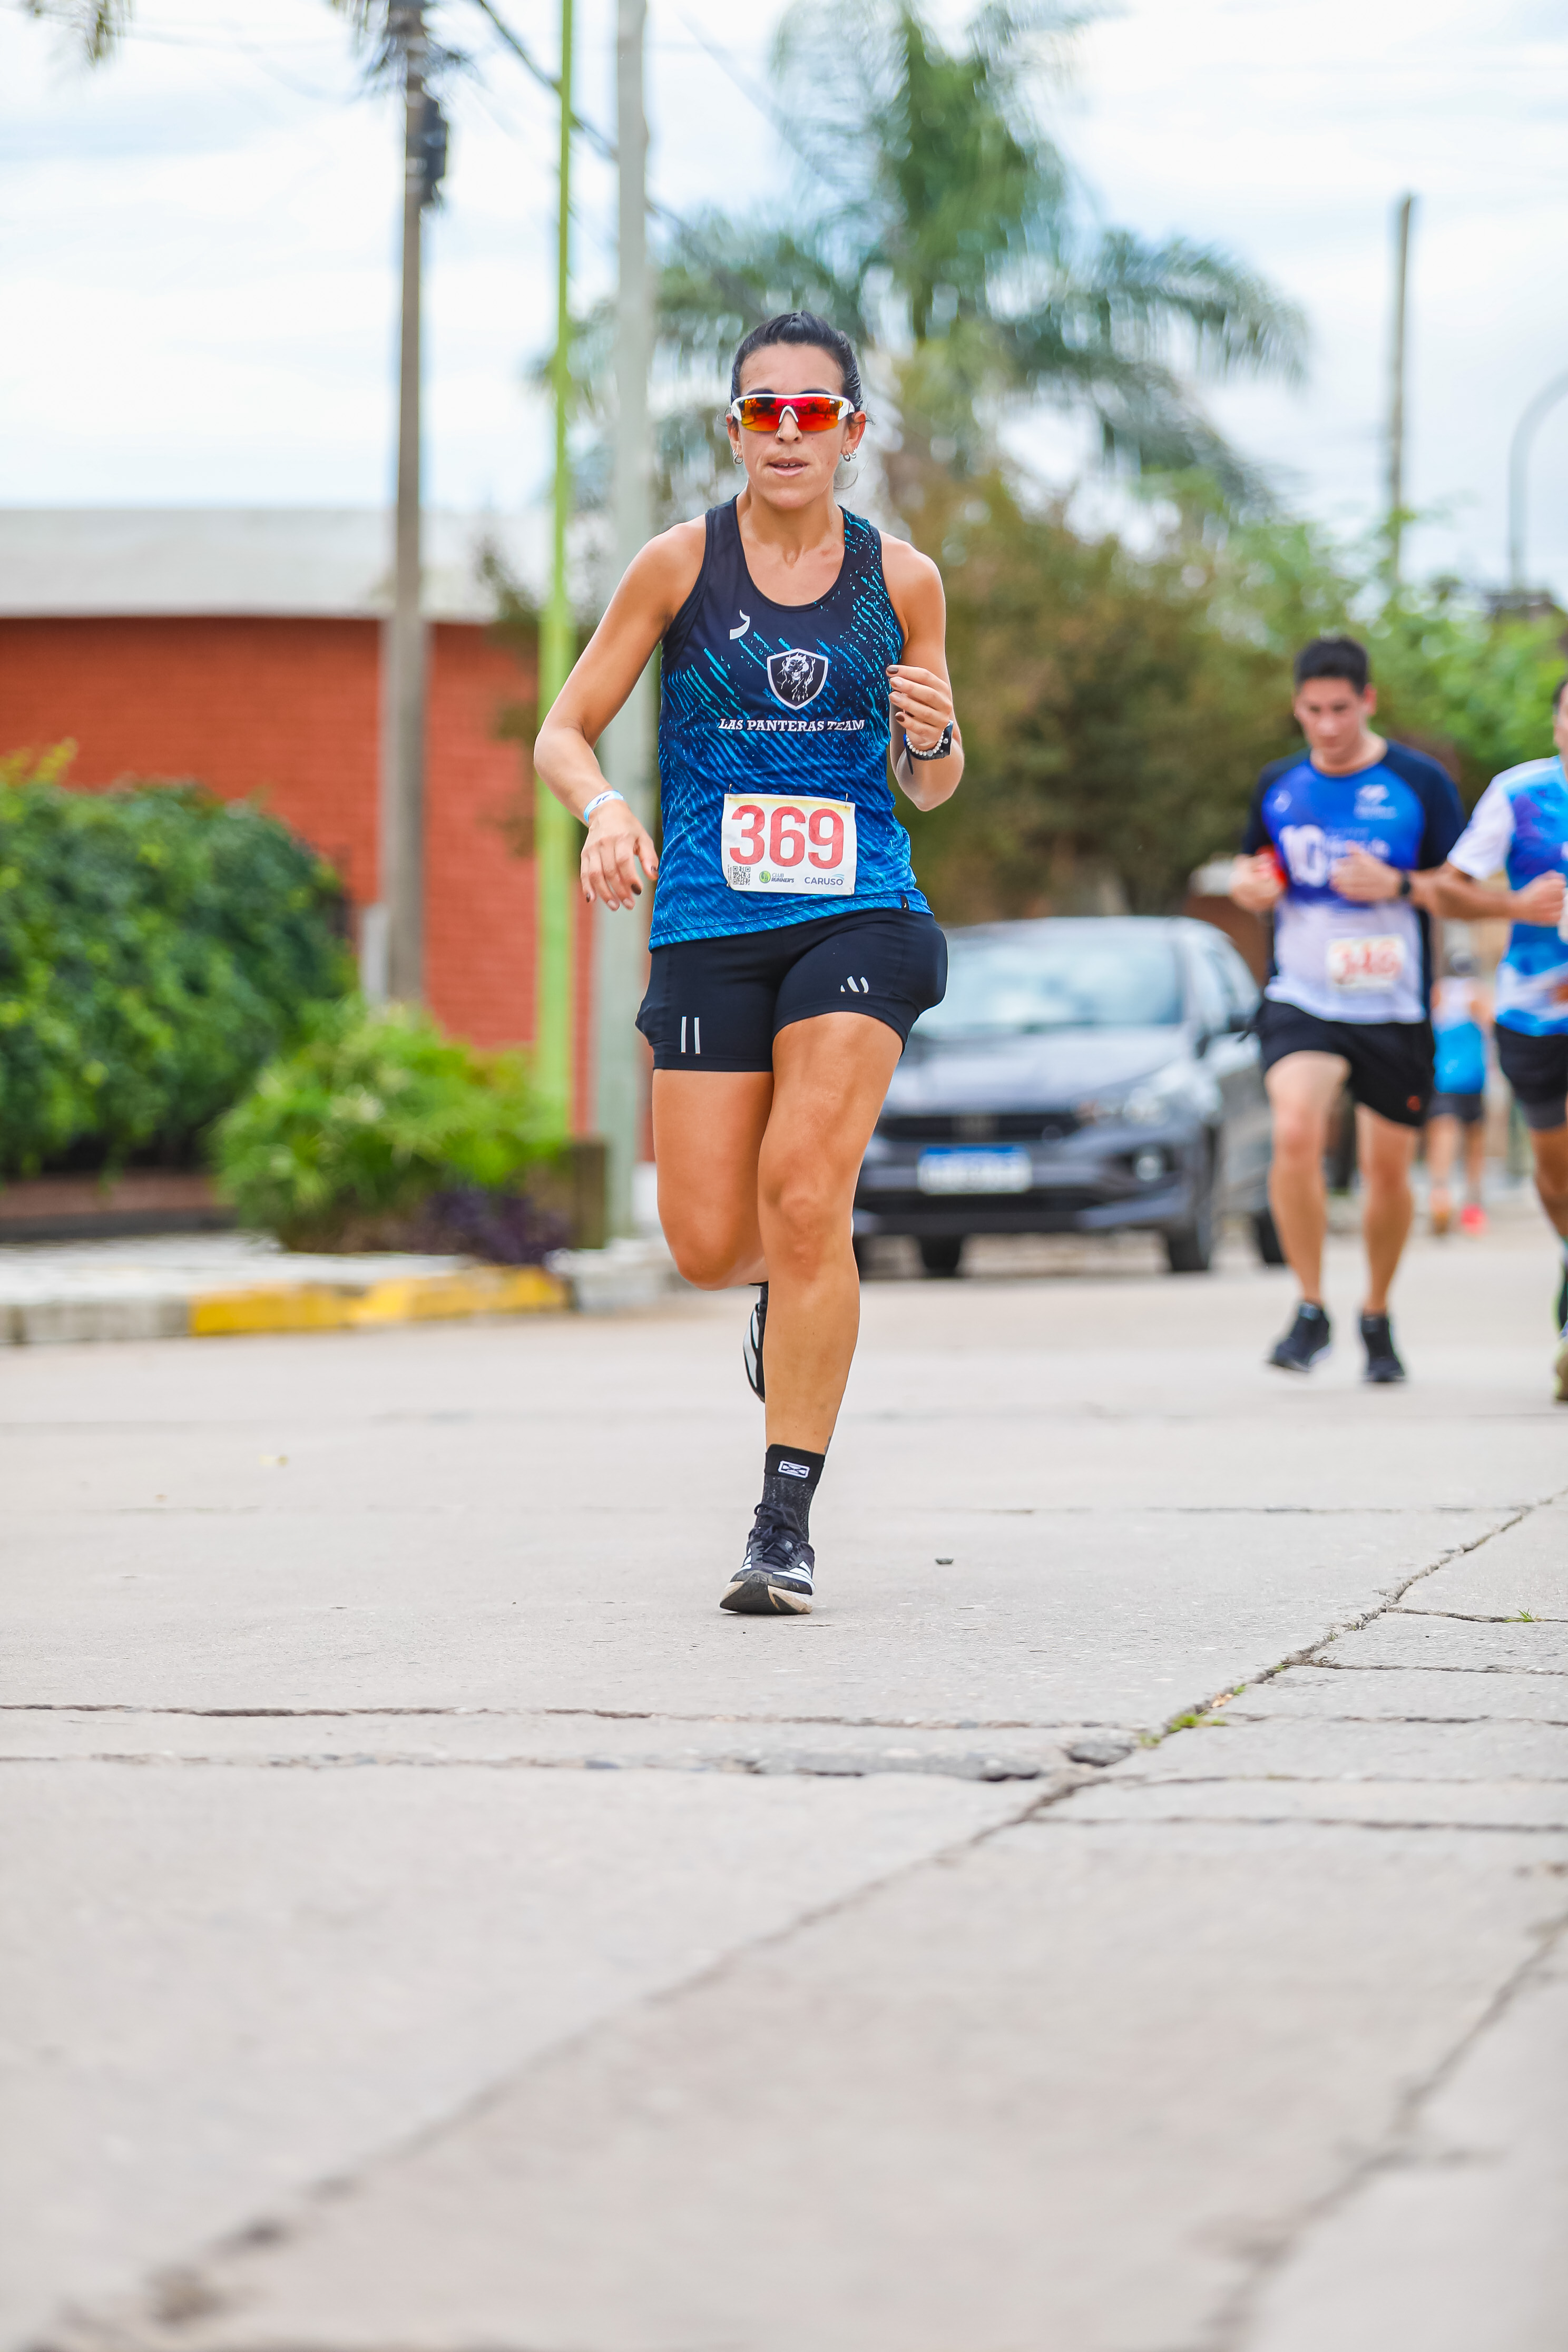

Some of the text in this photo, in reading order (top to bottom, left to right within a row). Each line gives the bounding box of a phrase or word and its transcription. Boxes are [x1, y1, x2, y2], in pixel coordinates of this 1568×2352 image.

[718, 718, 865, 731] LAS PANTERAS TEAM
[729, 805, 844, 869] 369
[804, 877, 844, 886] CARUSO
